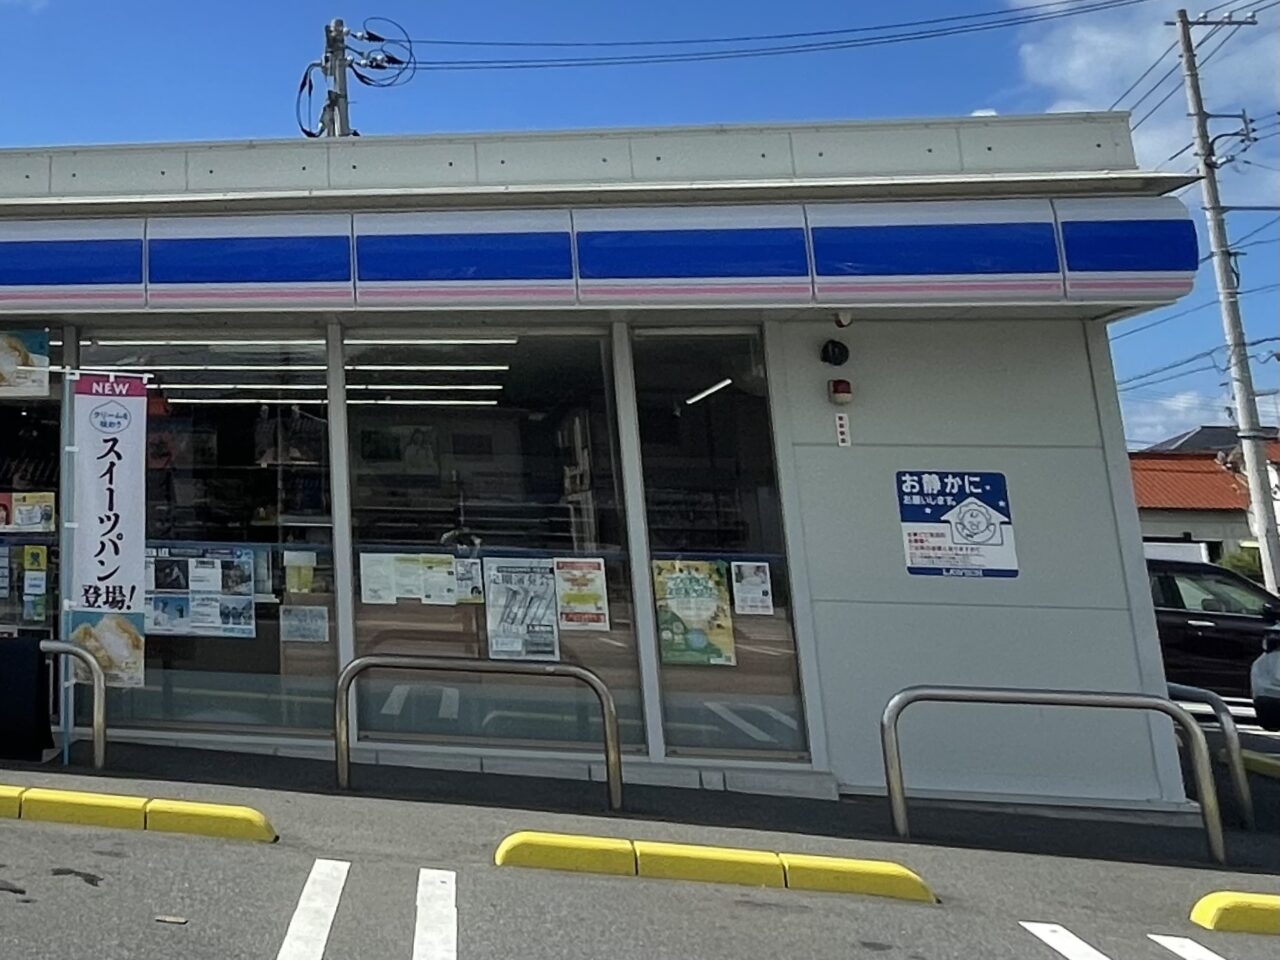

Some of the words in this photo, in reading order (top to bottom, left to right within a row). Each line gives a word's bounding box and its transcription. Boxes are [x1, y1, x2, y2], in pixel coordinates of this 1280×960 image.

[91, 382, 130, 395] NEW
[901, 473, 982, 494] お静かに
[81, 585, 137, 611] 登場!
